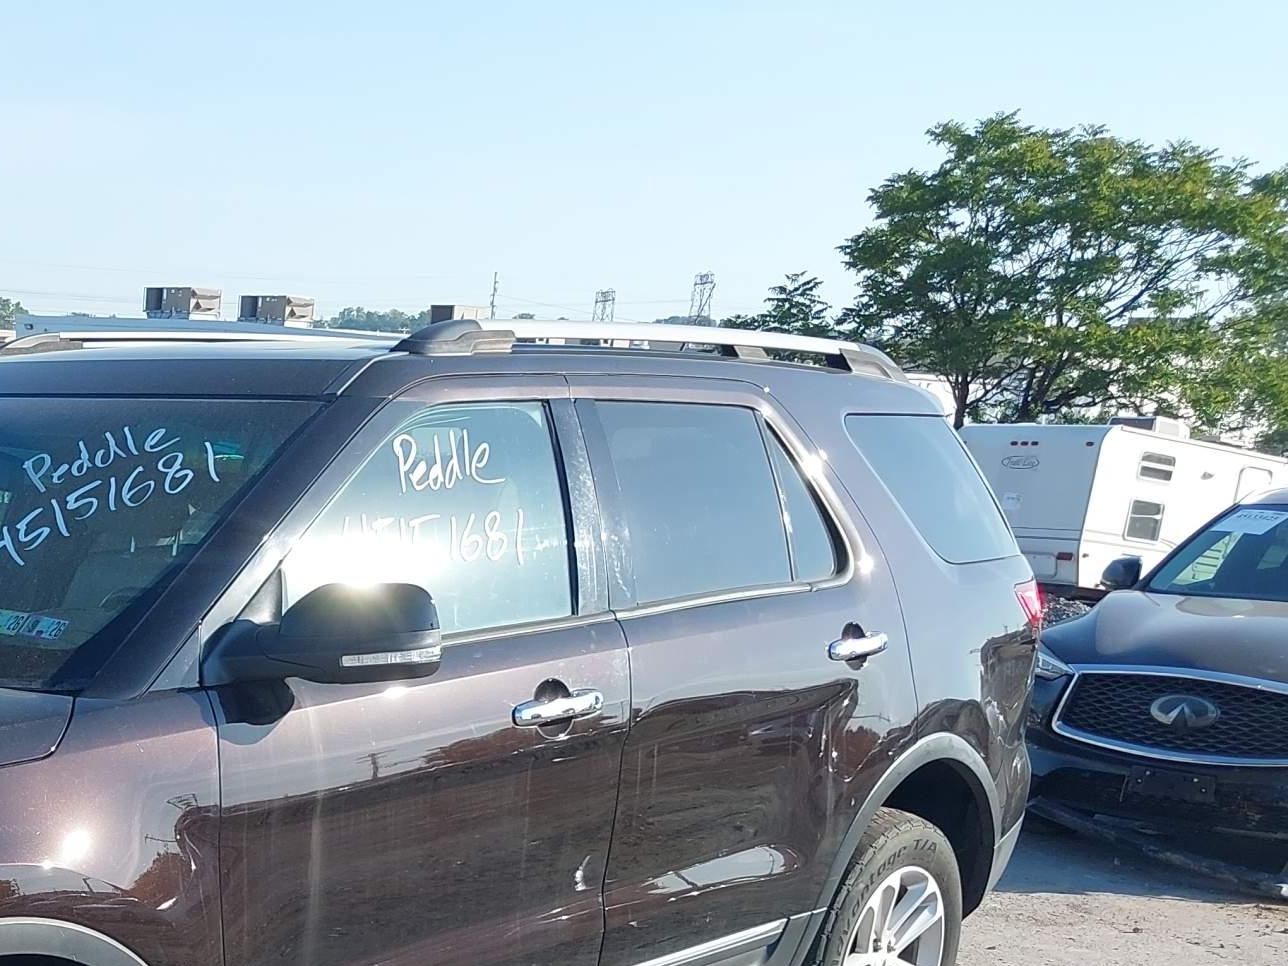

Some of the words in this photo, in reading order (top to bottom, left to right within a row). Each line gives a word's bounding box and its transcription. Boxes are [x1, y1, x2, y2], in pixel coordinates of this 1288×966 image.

[23, 426, 180, 492] Peddle
[392, 428, 506, 493] Peddle
[912, 838, 938, 852] T/A
